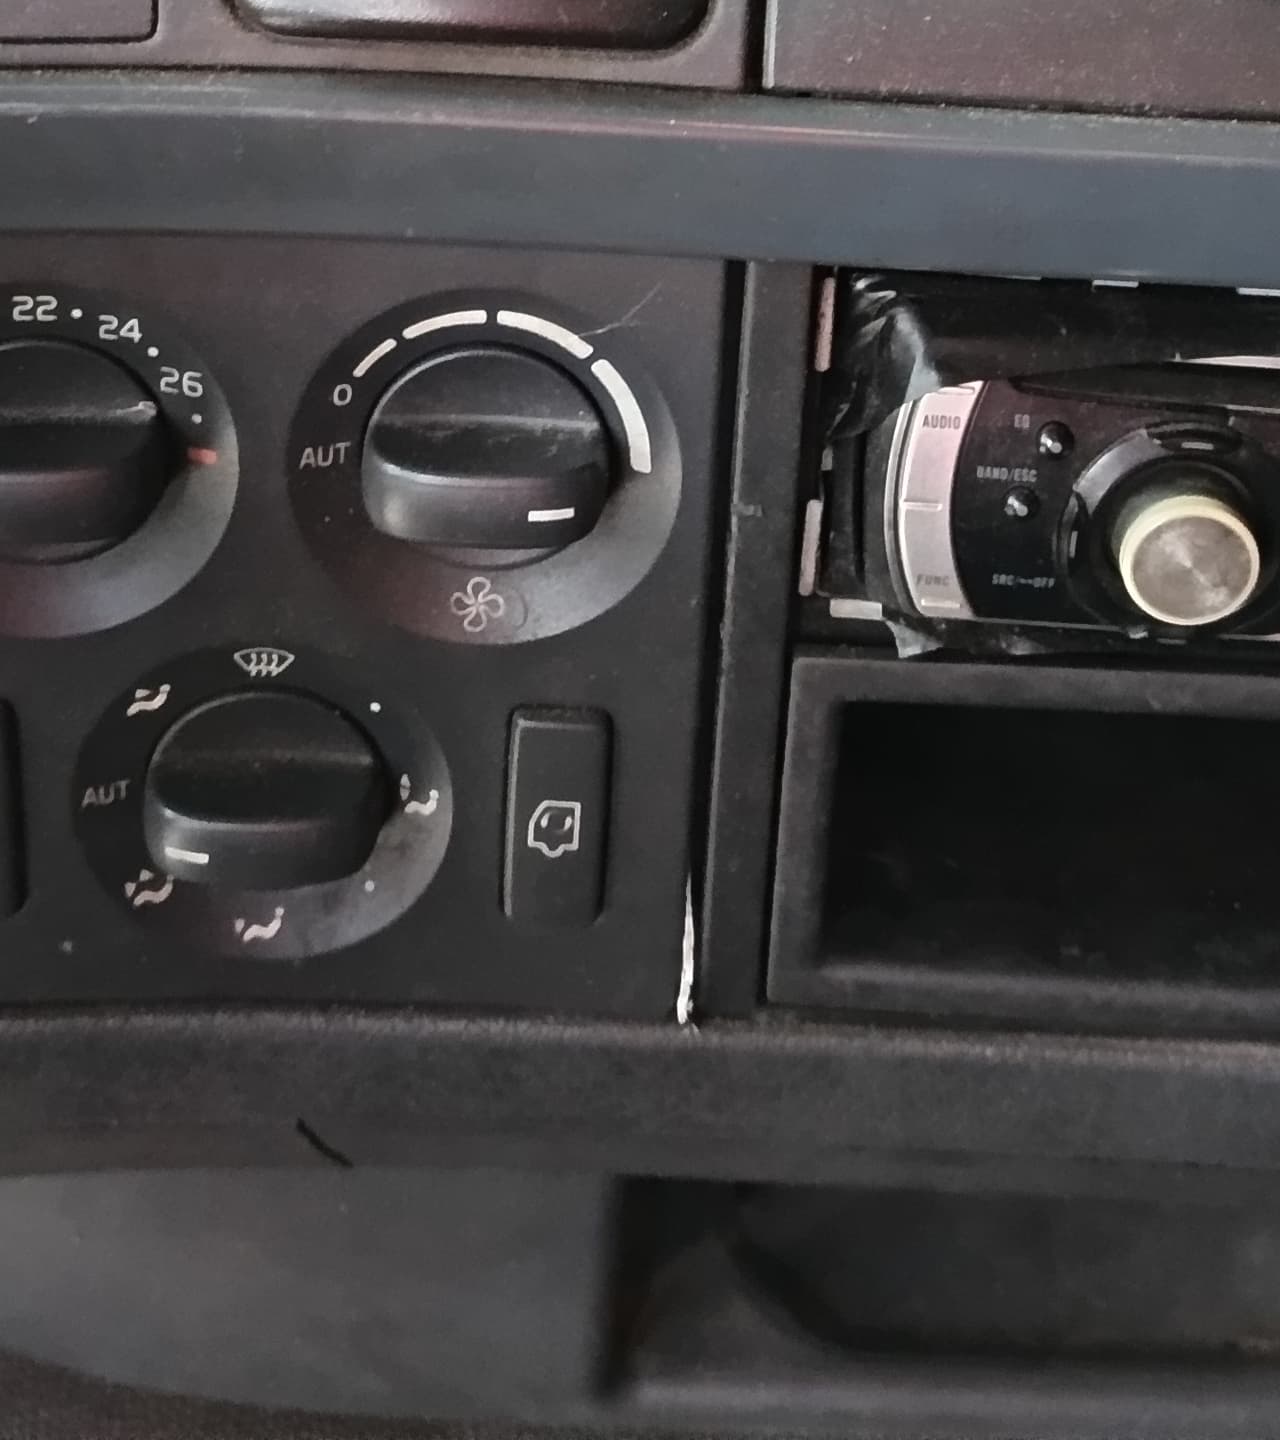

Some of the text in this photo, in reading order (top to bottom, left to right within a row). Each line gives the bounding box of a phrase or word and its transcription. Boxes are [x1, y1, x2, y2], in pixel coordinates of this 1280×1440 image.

[11, 295, 58, 322] 22
[98, 314, 143, 344] 24
[159, 366, 204, 398] 26
[922, 413, 962, 430] AUDIO
[299, 441, 351, 470] AUT
[976, 465, 1038, 482] BAND/ESC
[917, 574, 950, 586] FUNC
[81, 780, 130, 808] AUT
